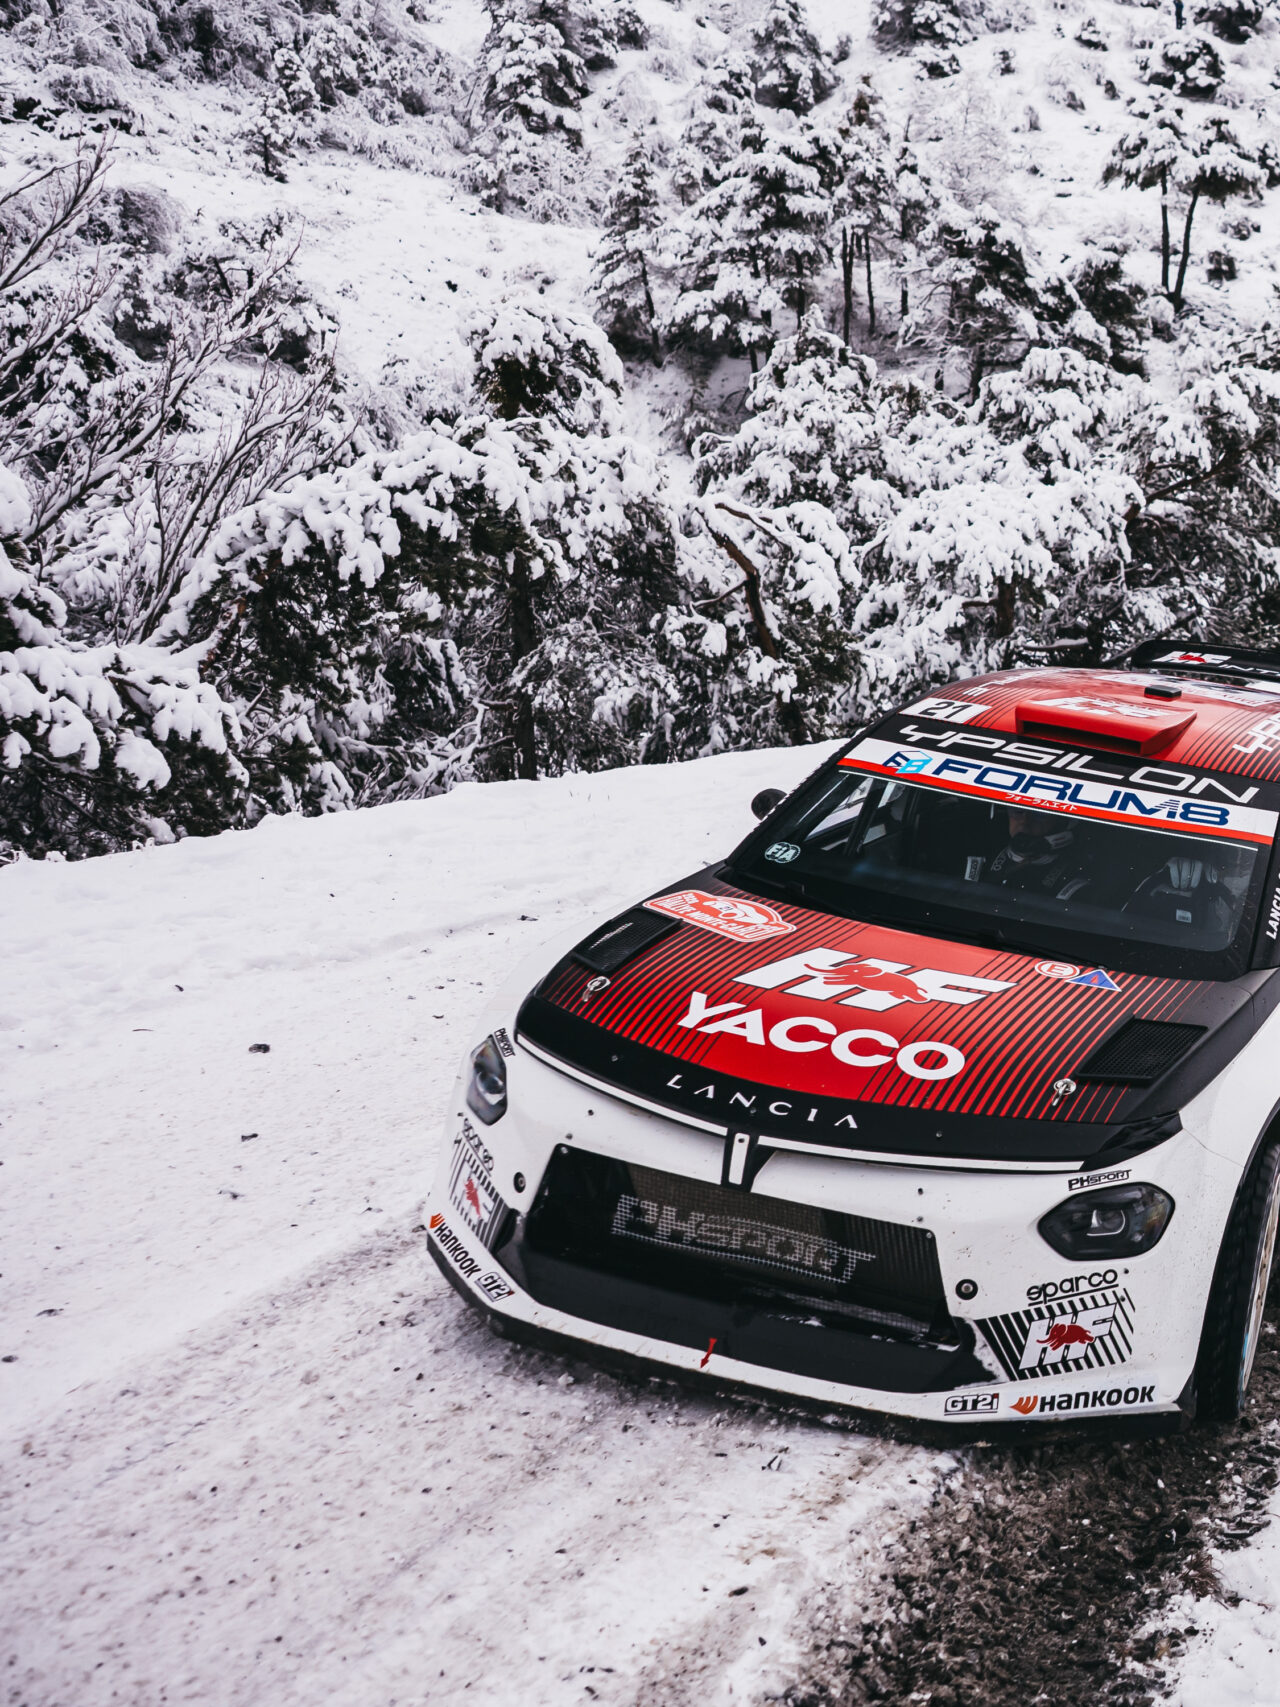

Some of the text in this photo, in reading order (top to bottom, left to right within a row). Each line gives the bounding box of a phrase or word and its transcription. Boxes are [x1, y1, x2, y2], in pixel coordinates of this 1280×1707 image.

[919, 701, 972, 719] 21
[899, 724, 1261, 804] YPSILON
[932, 758, 1230, 826] FORUM8
[1004, 792, 1078, 812] フォーラムエイト
[767, 844, 797, 862] FIA
[731, 946, 1019, 1012] HF
[676, 990, 966, 1080] YACCO
[666, 1073, 859, 1130] LANCIA
[1068, 1169, 1132, 1191] PHSPORT
[611, 1194, 877, 1283] PHSPORT
[1026, 1268, 1119, 1304] sparco
[1019, 1302, 1117, 1370] HF
[945, 1393, 1000, 1414] GT2i
